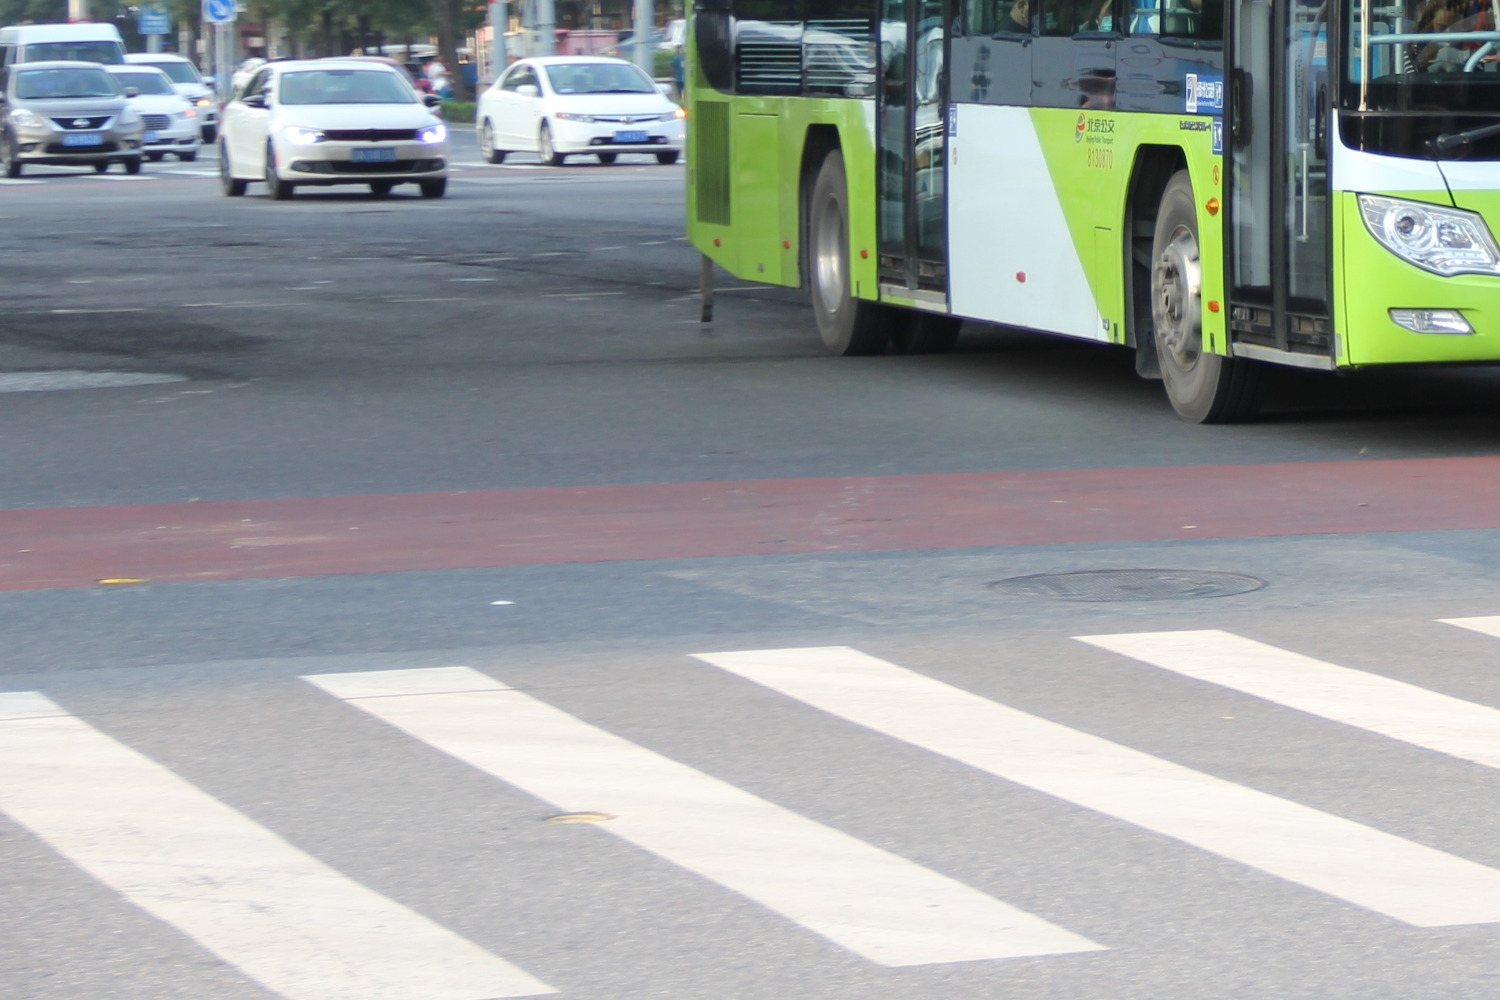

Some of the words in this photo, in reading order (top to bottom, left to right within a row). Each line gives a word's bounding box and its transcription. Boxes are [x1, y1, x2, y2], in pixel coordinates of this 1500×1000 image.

[1087, 118, 1115, 133] 北京公交
[1087, 147, 1113, 168] 8130870
